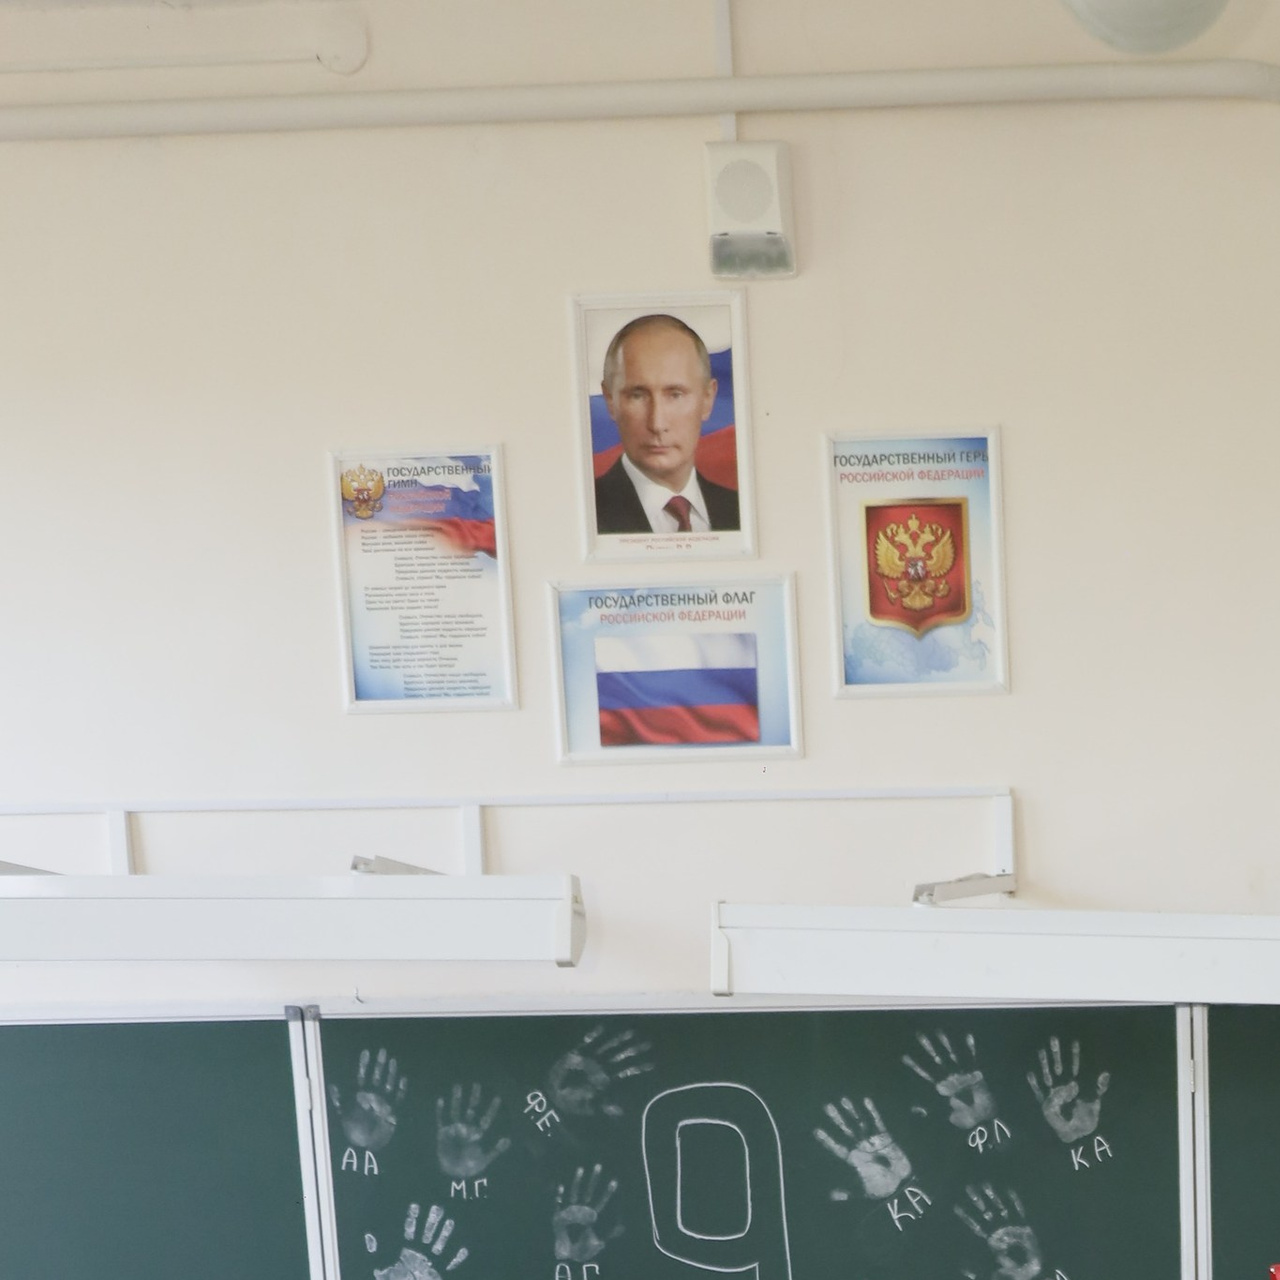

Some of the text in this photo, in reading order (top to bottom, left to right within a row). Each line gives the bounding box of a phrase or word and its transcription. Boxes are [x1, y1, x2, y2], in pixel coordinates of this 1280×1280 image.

[833, 450, 956, 467] ГОСУДАРСТВЕННЫЙ
[388, 479, 418, 489] ГИМН
[840, 467, 985, 484] РОССИЙСКОЙ ФЕДЕРАЦИИ
[588, 590, 756, 609] ГОСУДАРСТВЕННЫЙ ФЛАГ
[600, 609, 746, 625] РОССИЙСКОЙ ФЕДЕРАЦИИ
